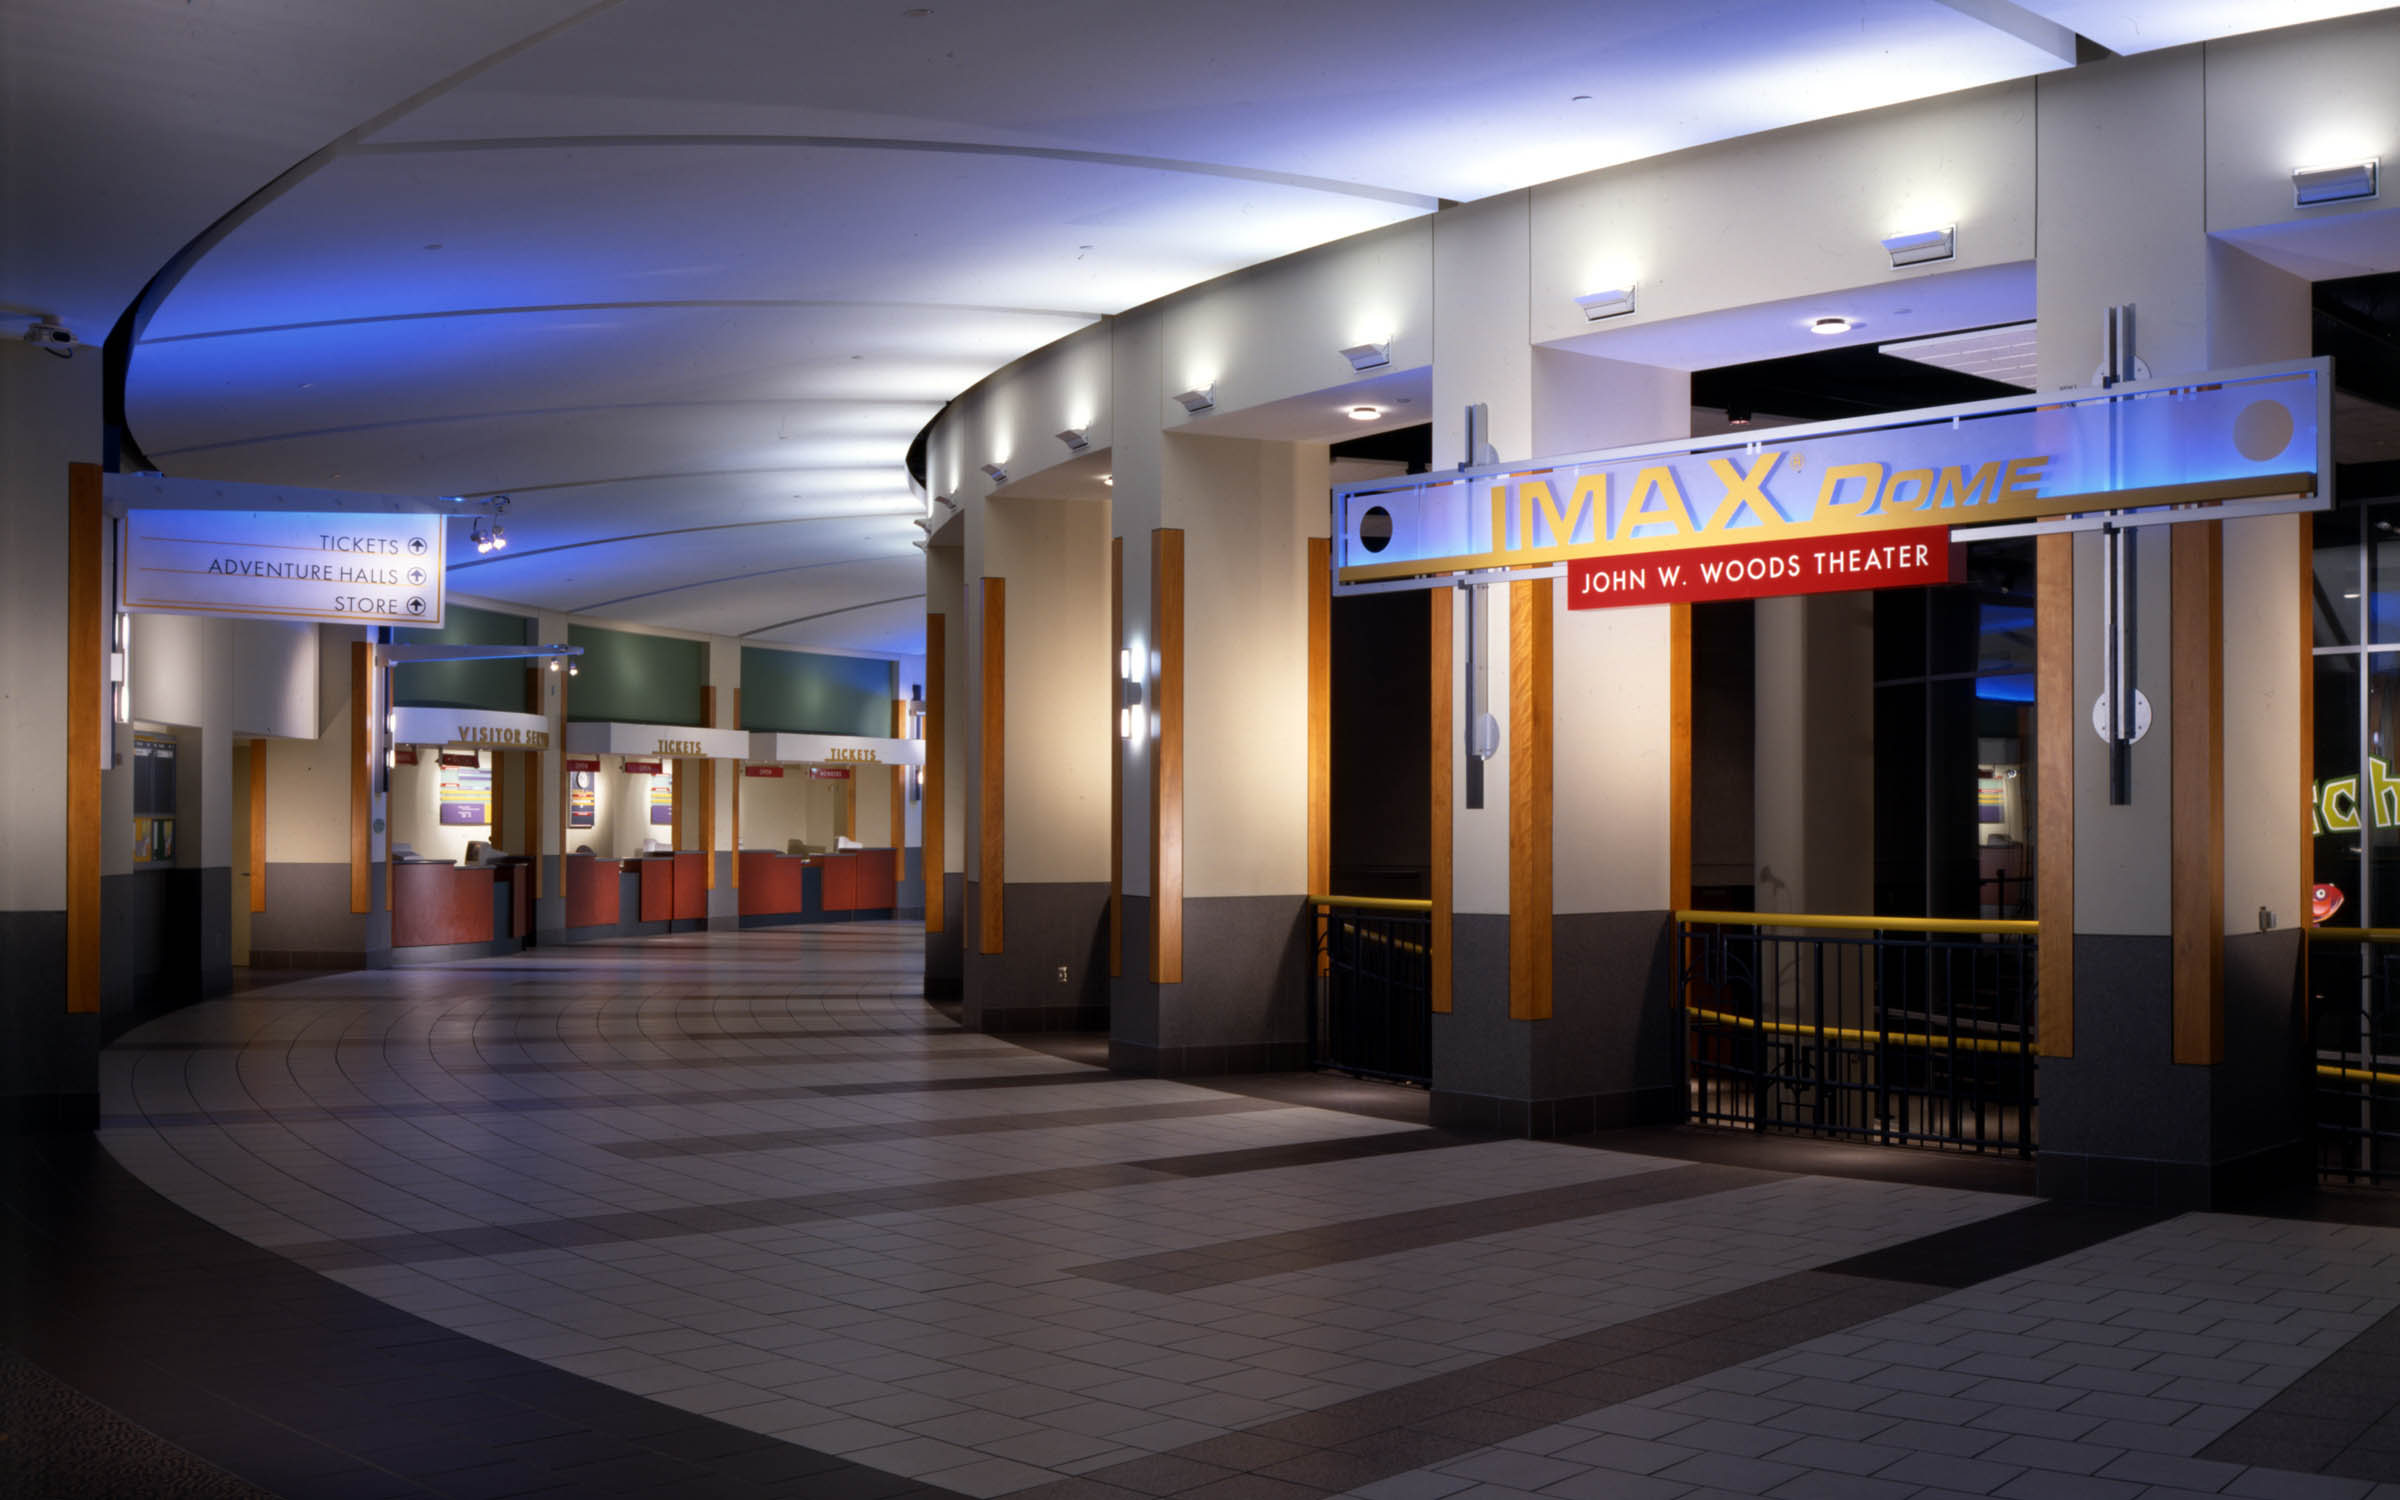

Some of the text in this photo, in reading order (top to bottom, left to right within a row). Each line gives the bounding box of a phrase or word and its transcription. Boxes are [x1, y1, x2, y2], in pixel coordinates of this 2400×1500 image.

[319, 534, 399, 556] TICKETS
[207, 558, 399, 585] ADVENTURE HALLS
[1581, 543, 1930, 595] JOHN W. WOODS THEATER
[334, 595, 398, 616] STORE
[458, 726, 521, 745] VISITOR
[657, 739, 702, 754] TICKETS
[830, 747, 877, 761] TICKETS
[2312, 755, 2400, 835] ch
